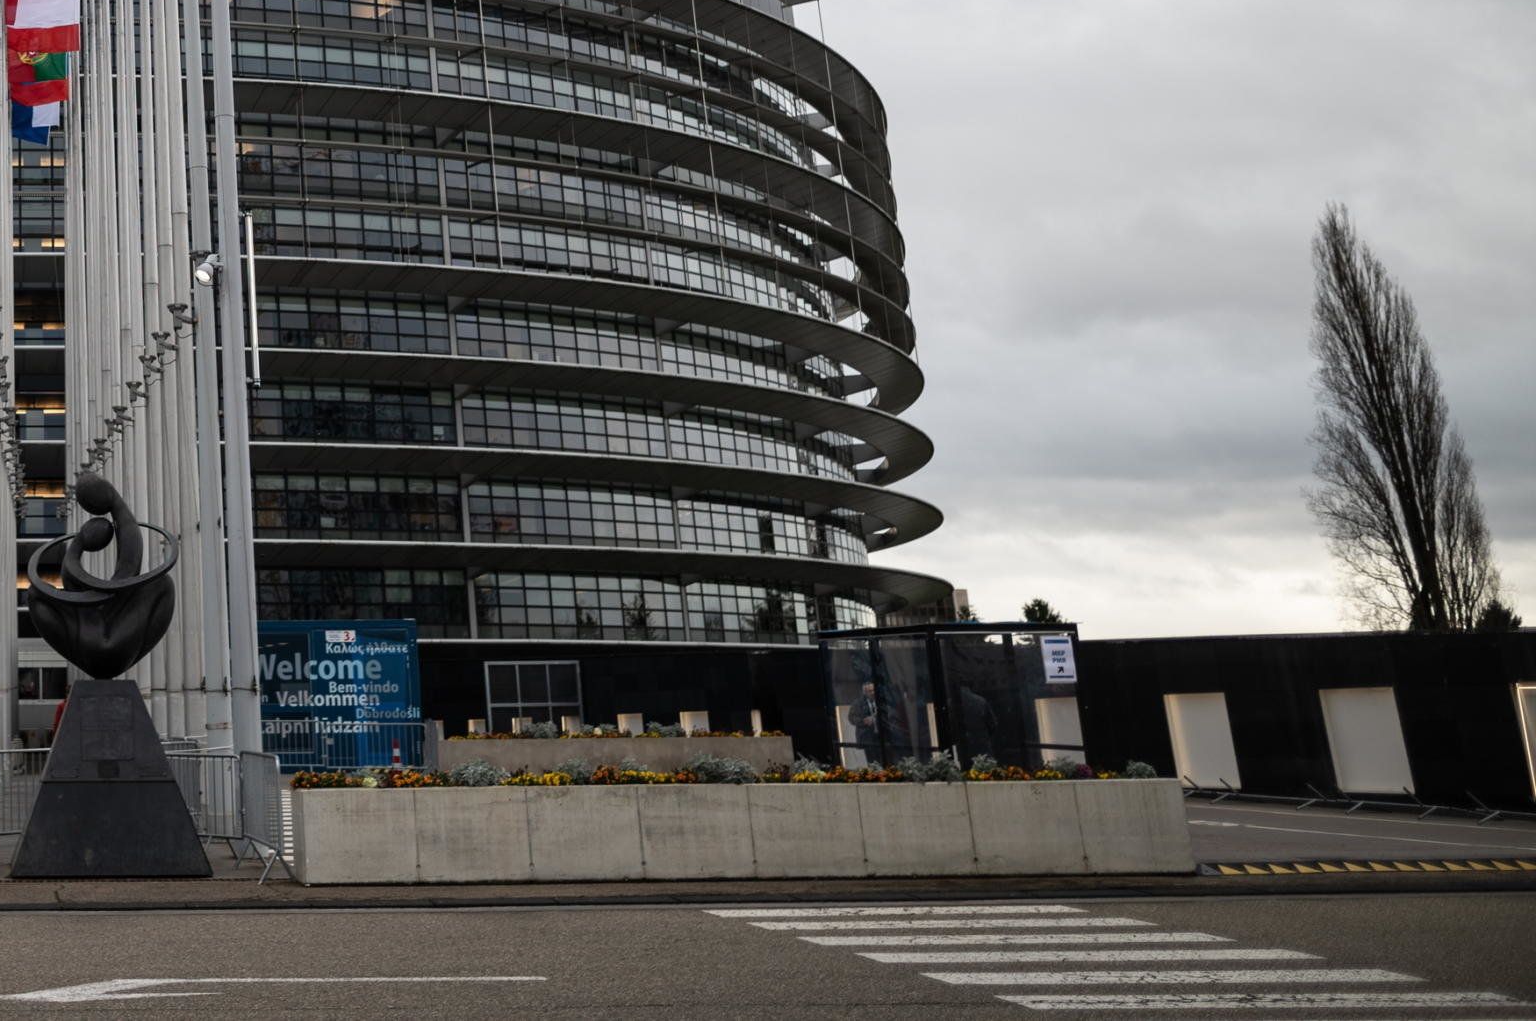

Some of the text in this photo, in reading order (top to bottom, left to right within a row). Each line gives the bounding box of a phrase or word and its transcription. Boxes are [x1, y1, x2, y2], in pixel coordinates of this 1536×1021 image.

[325, 642, 364, 655] Καλώς
[258, 652, 383, 681] Welcome
[328, 680, 399, 694] Bem-vindo
[276, 689, 381, 707] Velkommen
[261, 717, 309, 739] aipni
